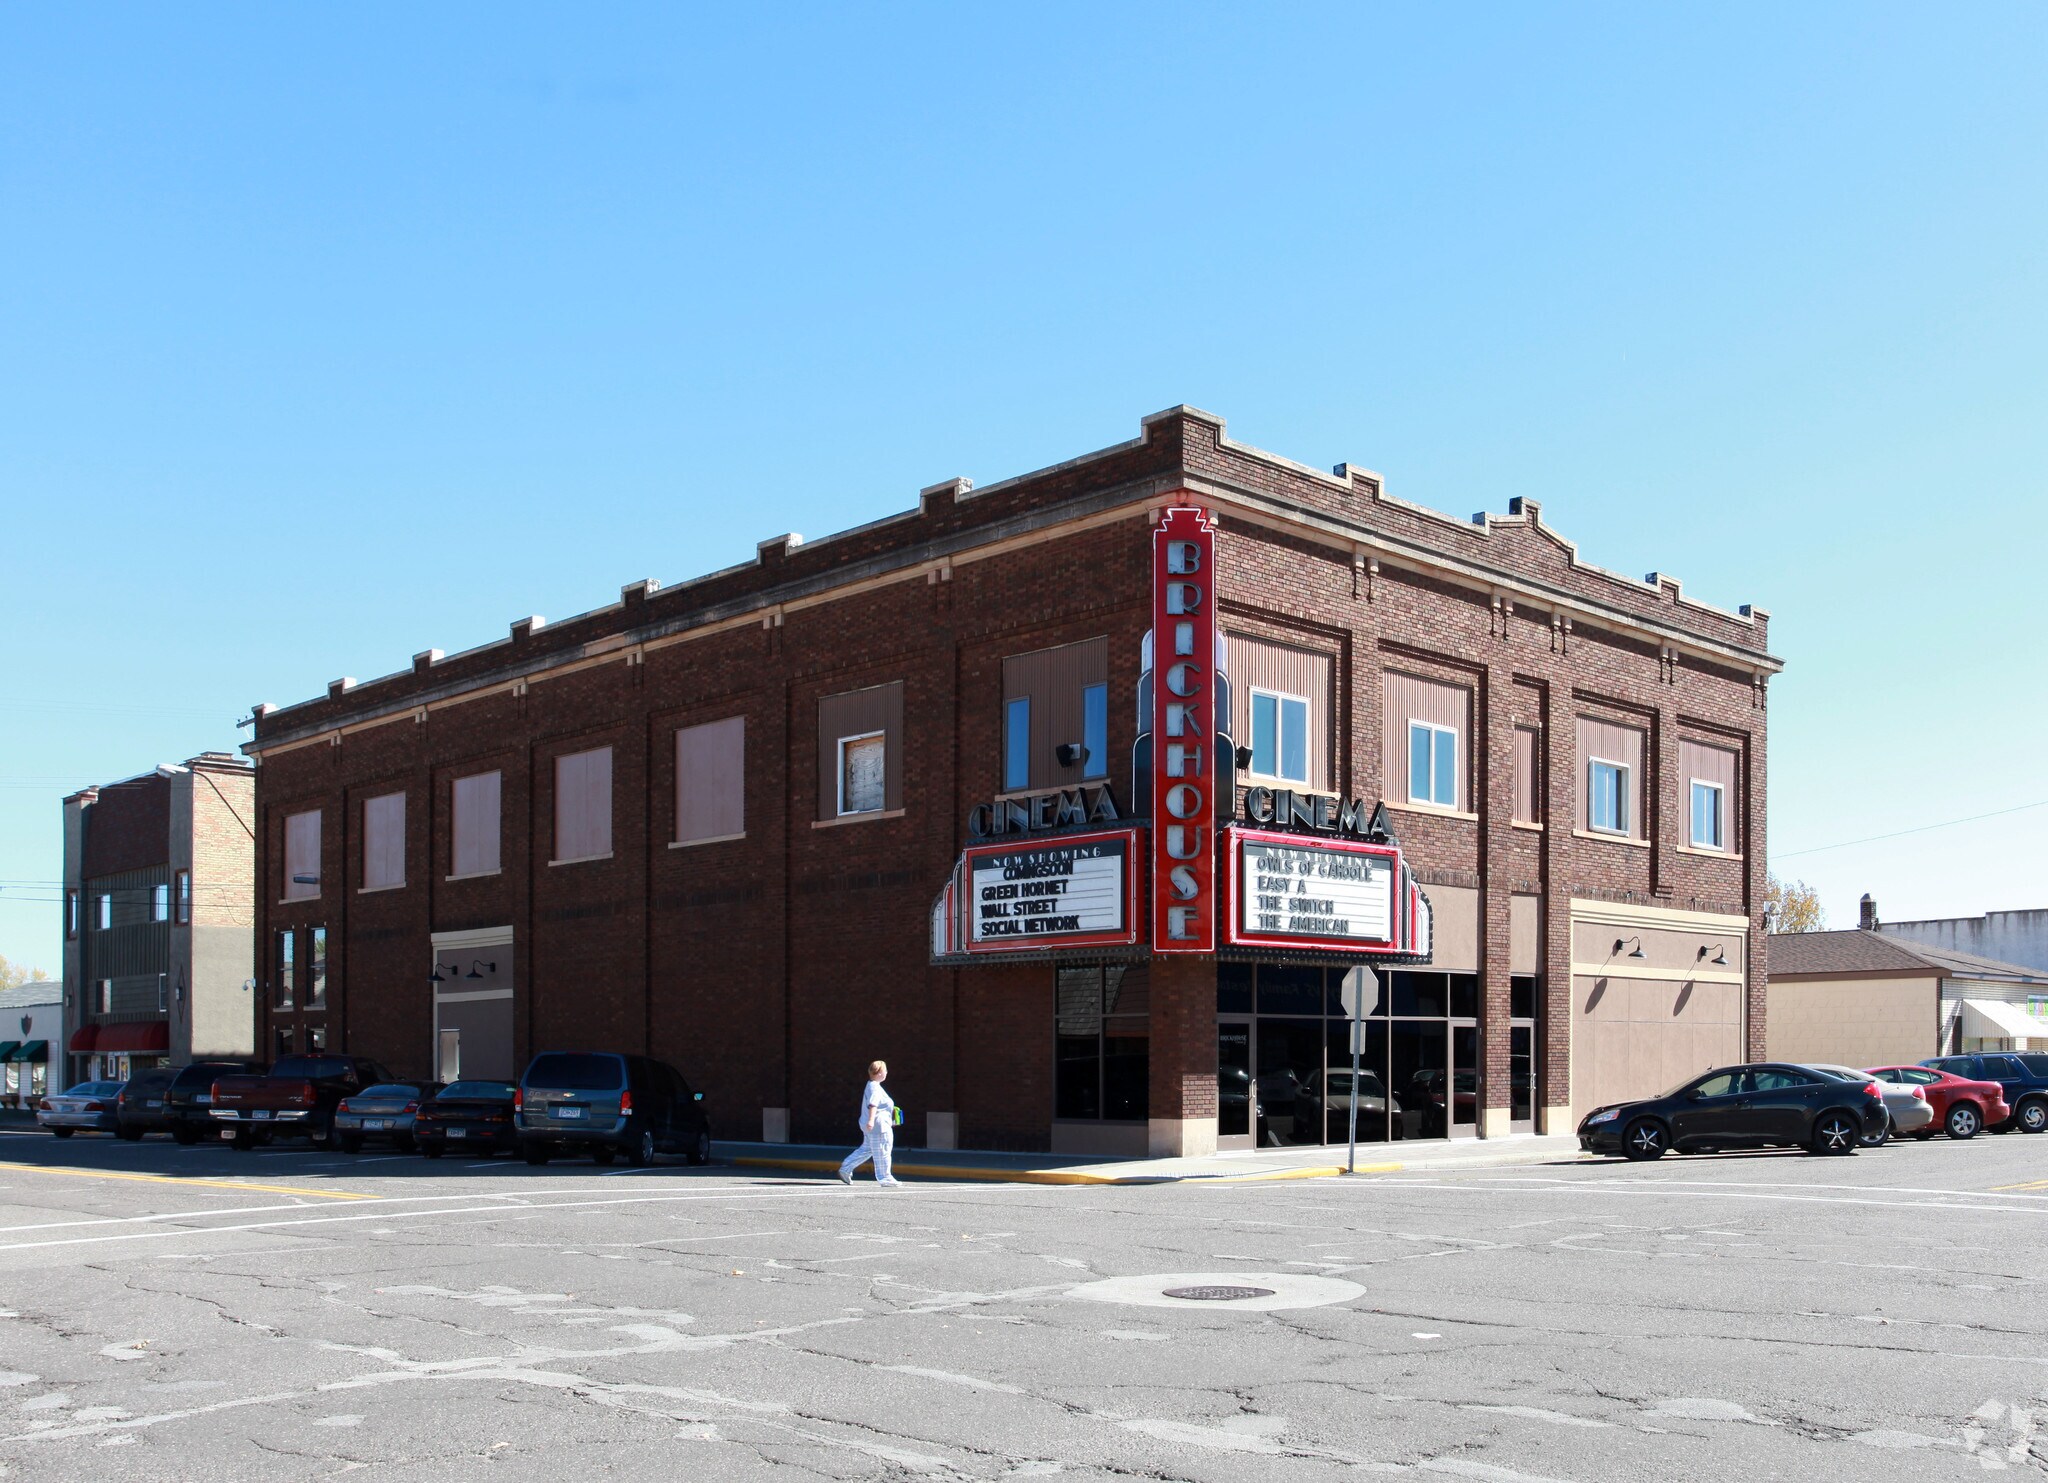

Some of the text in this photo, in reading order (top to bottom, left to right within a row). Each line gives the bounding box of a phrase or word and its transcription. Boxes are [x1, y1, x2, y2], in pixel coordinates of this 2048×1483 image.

[1166, 540, 1202, 941] BRICKHOUSE
[969, 783, 1119, 837] CINEMA
[1246, 786, 1395, 837] CINEMA
[993, 847, 1101, 867] NOW SHOWING
[1266, 848, 1372, 867] NOW SHOWING
[1257, 857, 1372, 882] OWLS OF GAHOOLE
[982, 879, 1069, 901] GREEN HORNET
[1257, 875, 1307, 894] EASY A
[981, 899, 1058, 918] WALL STREET
[1257, 895, 1334, 915] THE SWITCH
[982, 915, 1080, 936] SOCIAL NETWORK
[1257, 913, 1349, 934] THE AMERICAN
